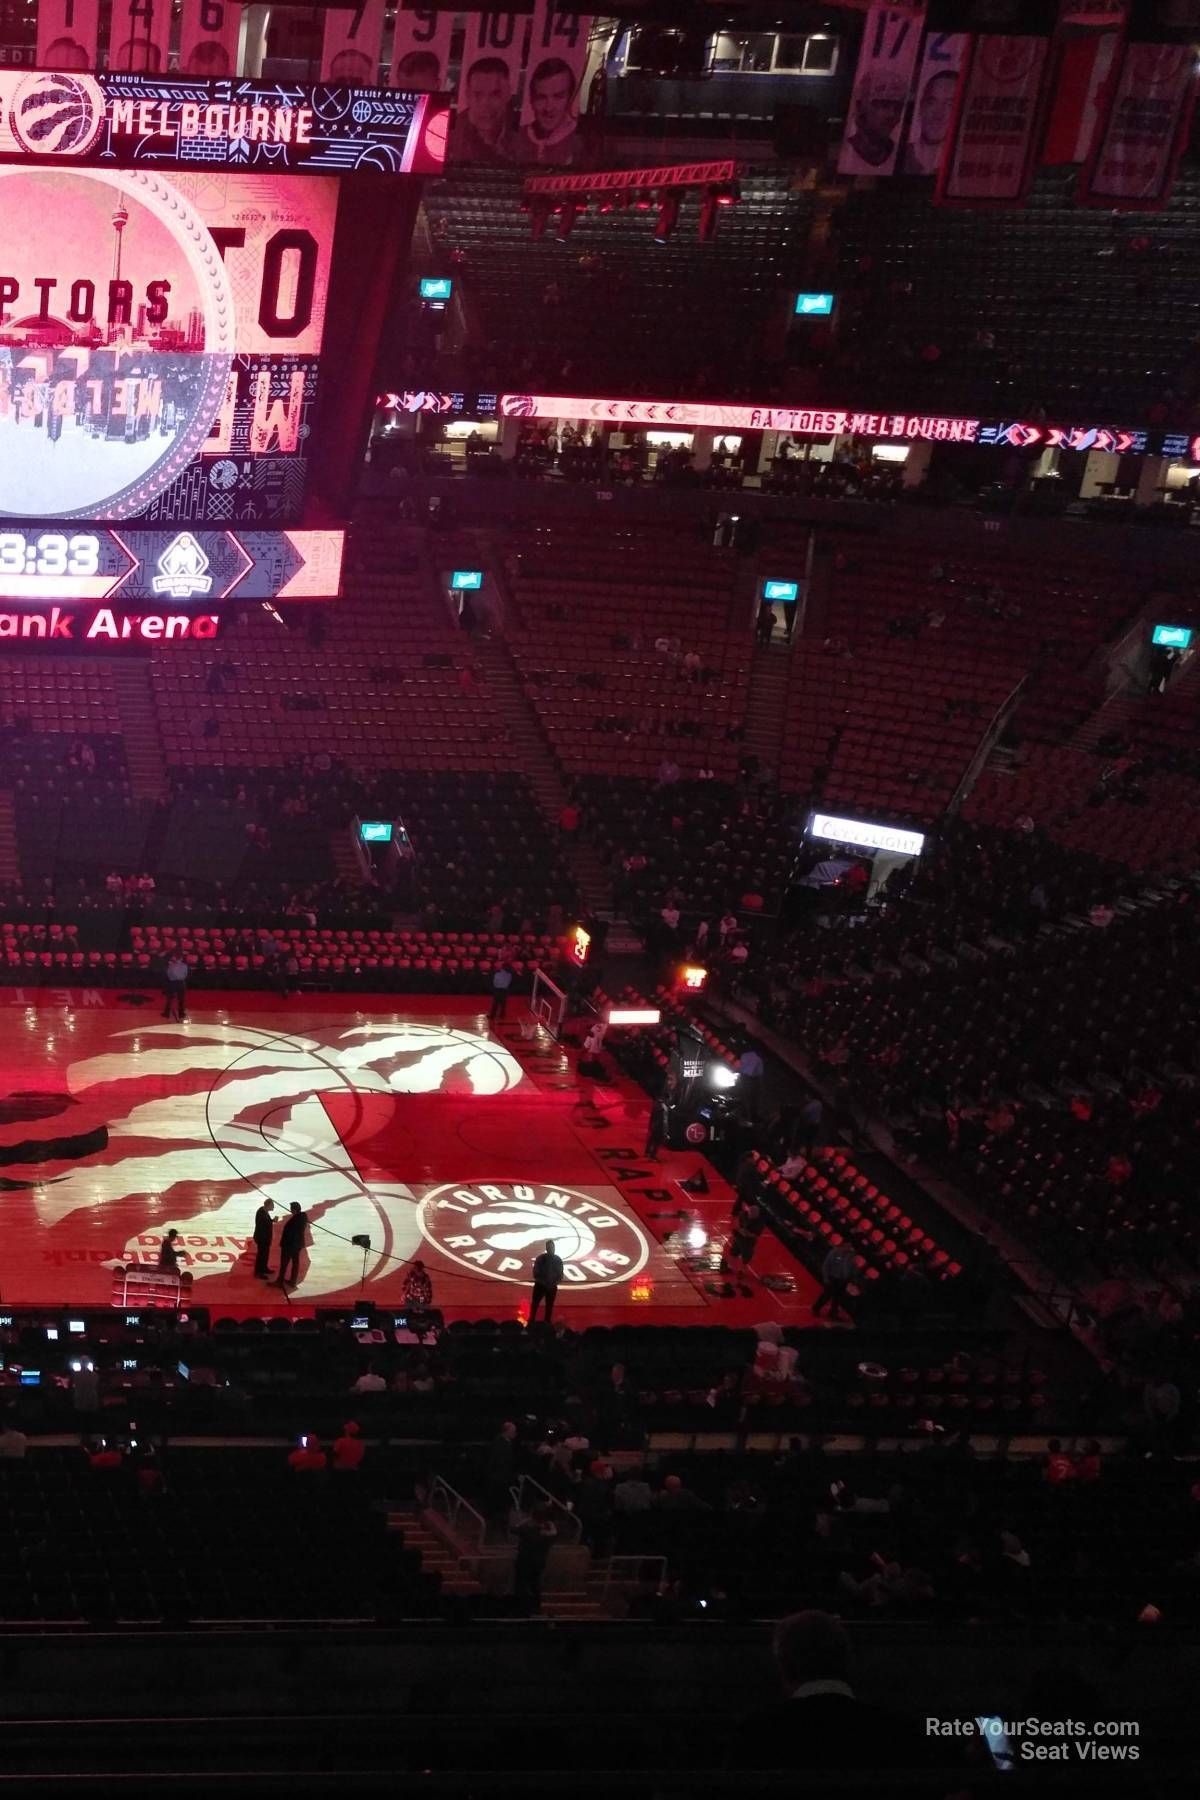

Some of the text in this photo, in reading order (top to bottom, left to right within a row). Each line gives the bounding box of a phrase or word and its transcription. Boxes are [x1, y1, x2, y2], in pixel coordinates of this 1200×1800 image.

[112, 100, 313, 145] MELBOURNE
[851, 414, 979, 442] MELBOURNE
[87, 608, 219, 640] Arena
[871, 834, 916, 850] LIGHT
[52, 989, 105, 1006] WE
[437, 1184, 619, 1228] TORONTO
[443, 1234, 631, 1282] RAPORS
